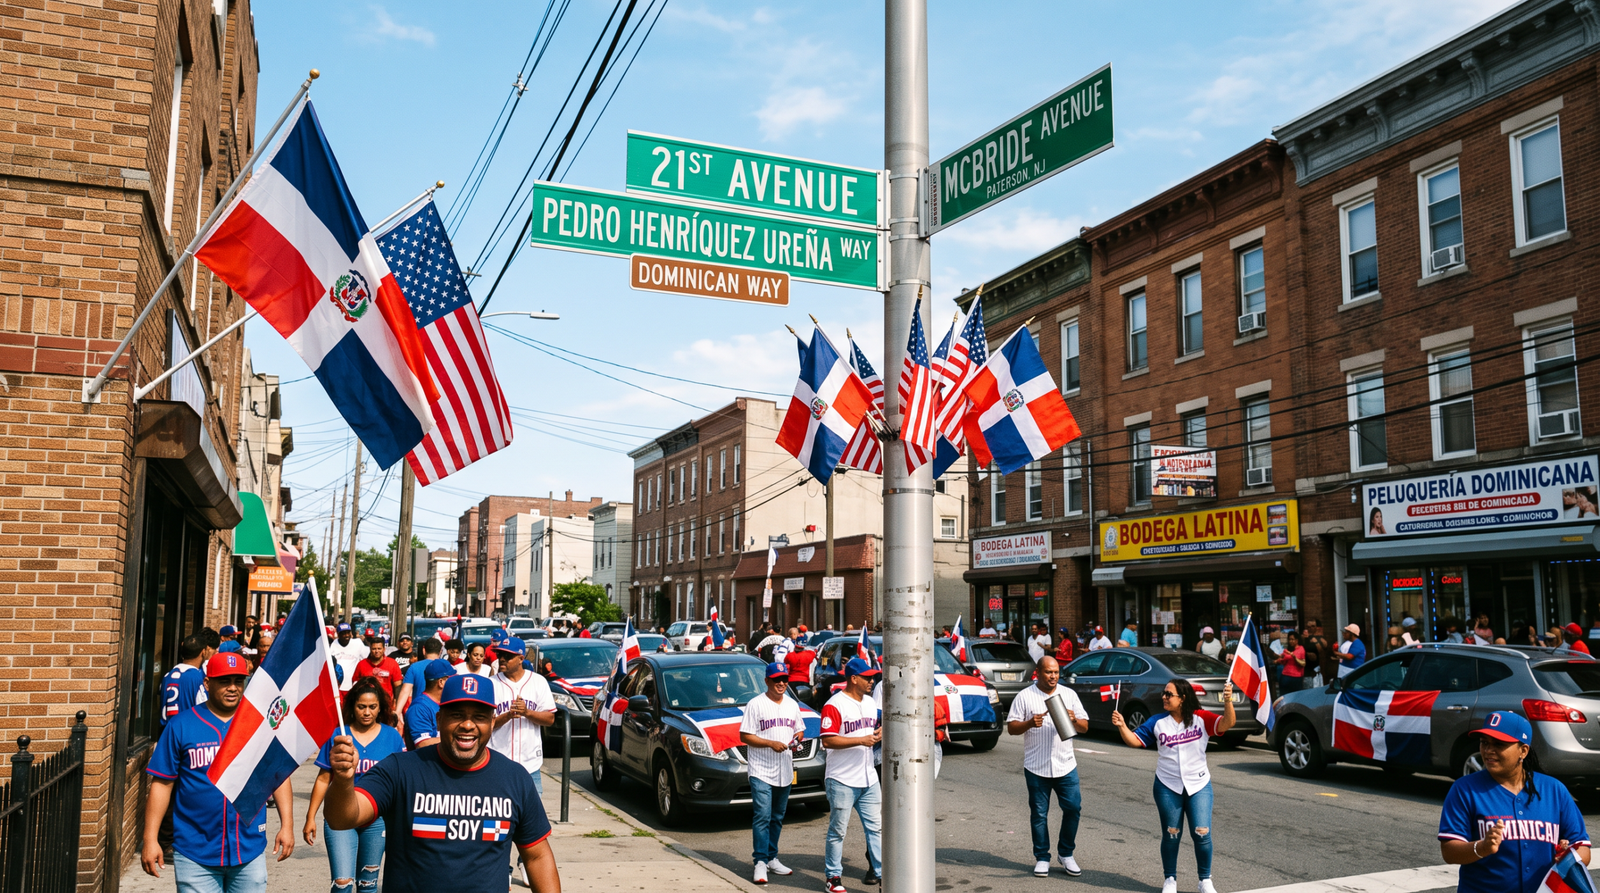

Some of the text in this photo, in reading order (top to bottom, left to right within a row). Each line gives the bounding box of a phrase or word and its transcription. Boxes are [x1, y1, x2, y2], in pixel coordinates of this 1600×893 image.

[945, 119, 1033, 203] MCBRIDE
[1040, 79, 1104, 140] AVENUE
[651, 146, 858, 216] 21ST AVENUE
[987, 159, 1046, 199] PATERSON, NJ
[542, 196, 871, 271] PEDRO HENRÍQUEZ UREÑA WAY
[638, 262, 782, 299] DOMINICAN WAY
[1368, 460, 1595, 506] PELUQUERÍA DOMINICANA
[981, 535, 1045, 551] BODEGA LATINA
[1119, 507, 1264, 546] BODEGA LATINA
[413, 792, 512, 818] DOMINICANO
[447, 819, 481, 841] SOY
